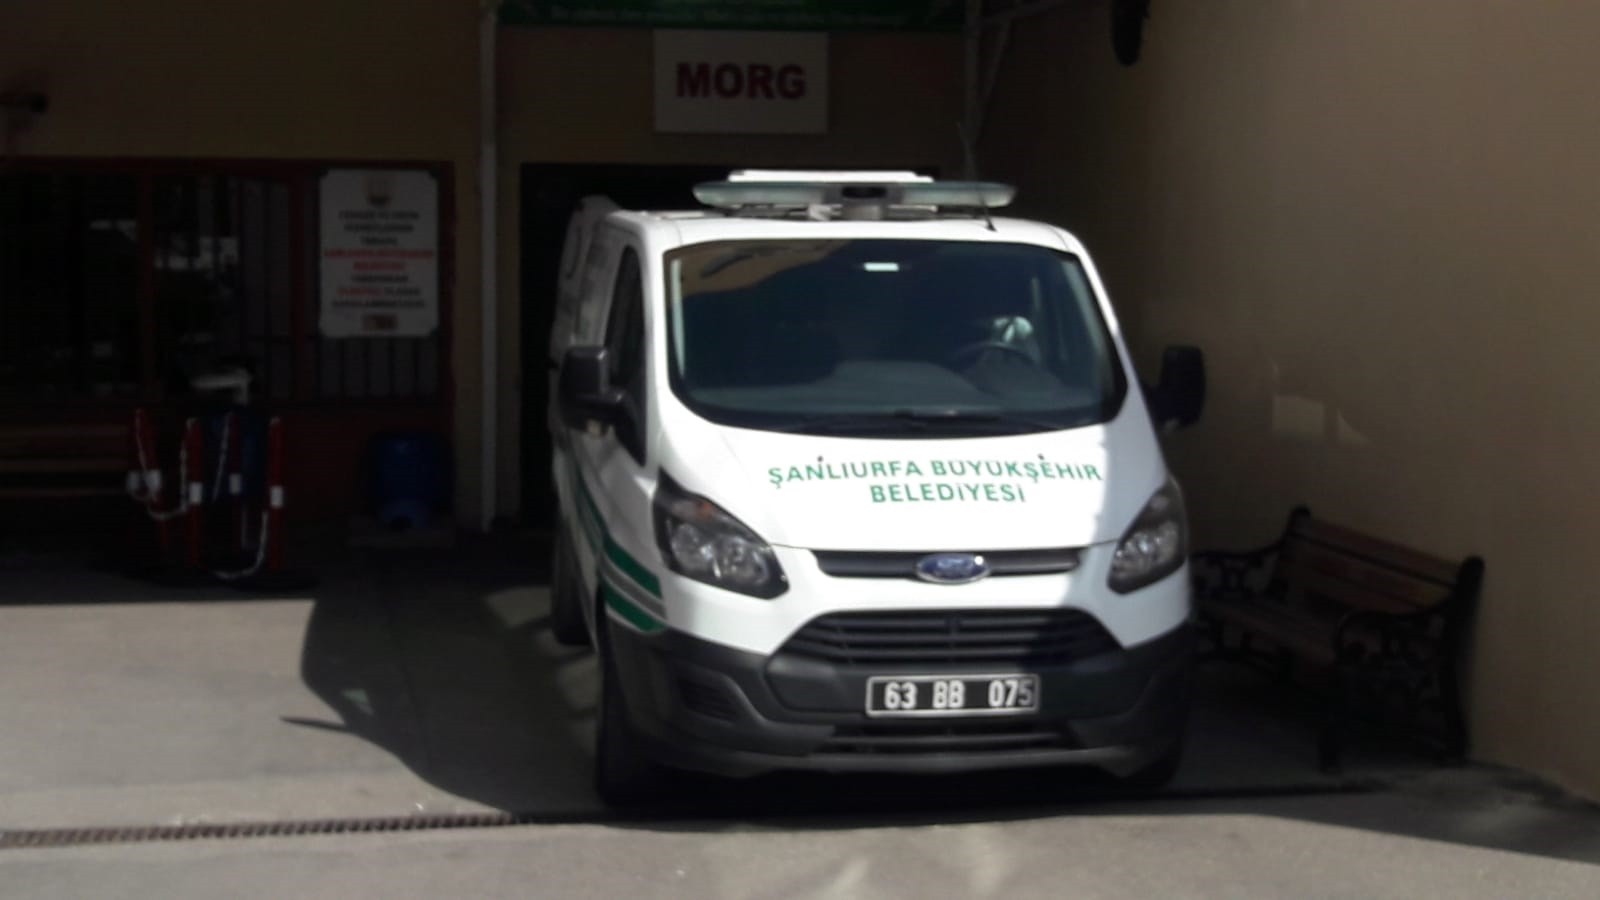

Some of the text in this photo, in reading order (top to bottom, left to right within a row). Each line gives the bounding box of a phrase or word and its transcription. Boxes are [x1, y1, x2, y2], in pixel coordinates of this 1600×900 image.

[676, 62, 807, 99] MORG
[768, 460, 923, 489] ŞANLIURFA
[884, 681, 917, 710] 63
[988, 678, 1034, 708] 075
